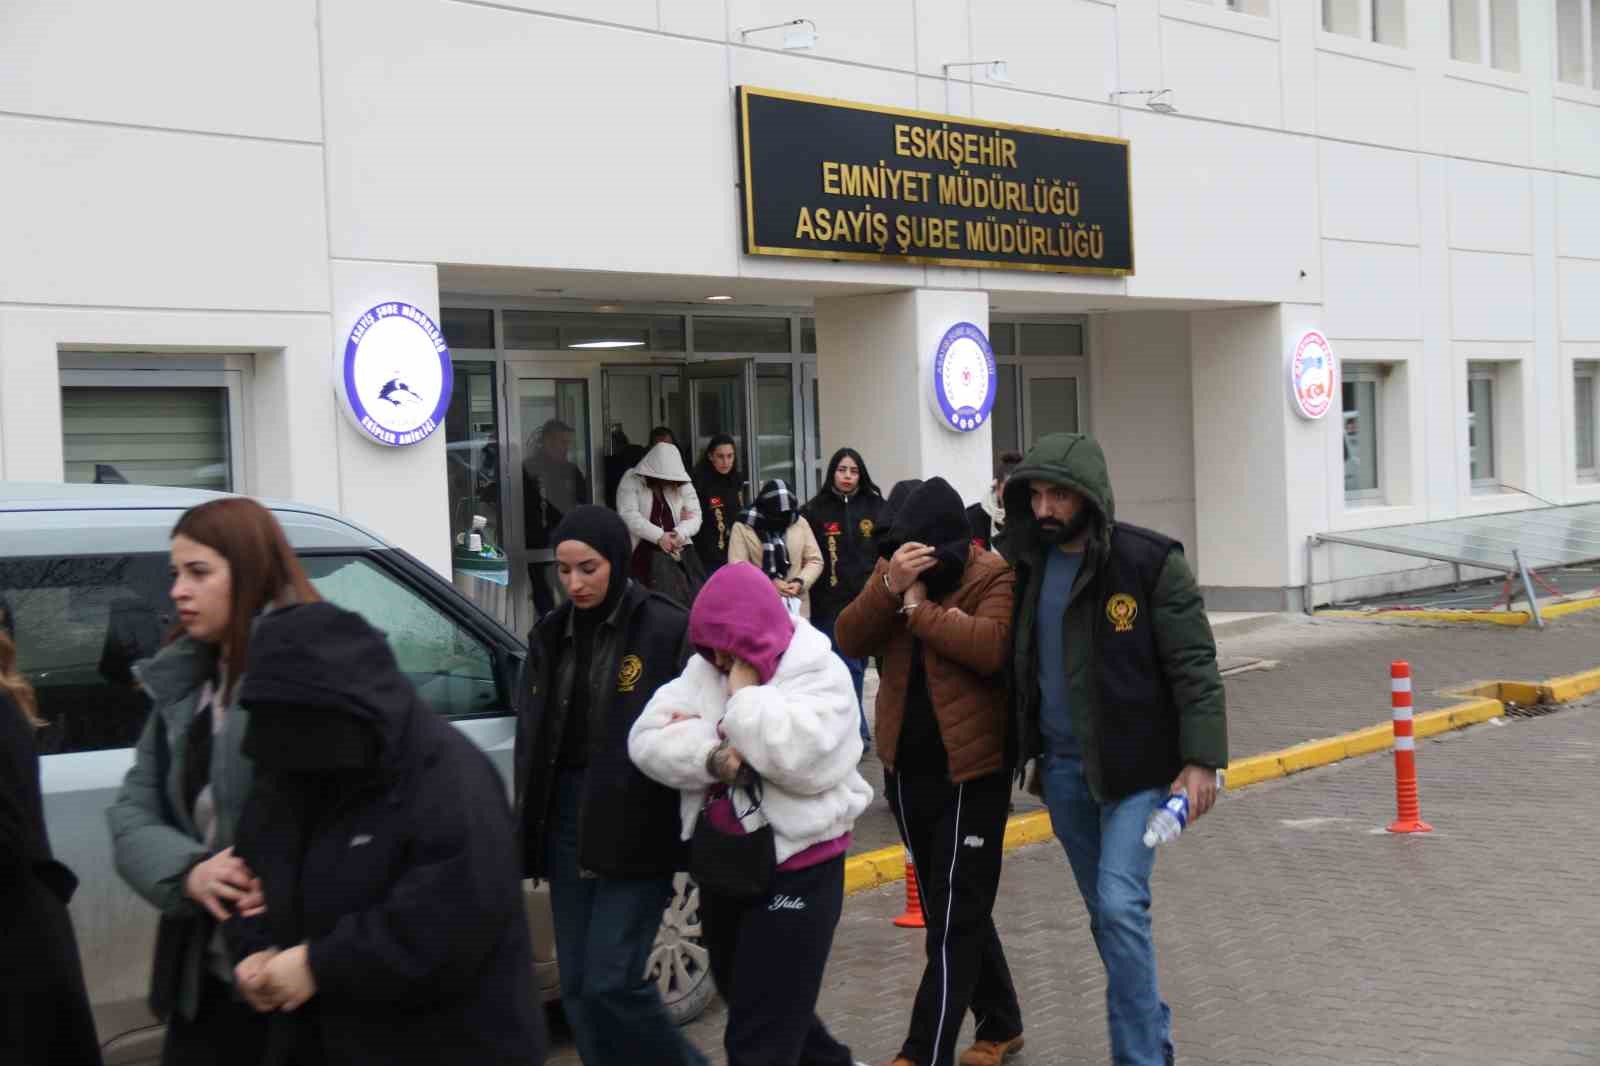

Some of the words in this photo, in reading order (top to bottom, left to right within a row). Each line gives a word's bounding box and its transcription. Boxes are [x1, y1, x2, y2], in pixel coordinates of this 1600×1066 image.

[894, 123, 1017, 169] ESKİŞEHİR
[823, 160, 931, 203] EMNİYET
[938, 170, 1080, 217] MÜDÜRLÜĞÜ
[796, 204, 889, 252] ASAYİŞ
[895, 214, 960, 254] ŞUBE
[965, 215, 1103, 259] MÜDÜRLÜĞÜ
